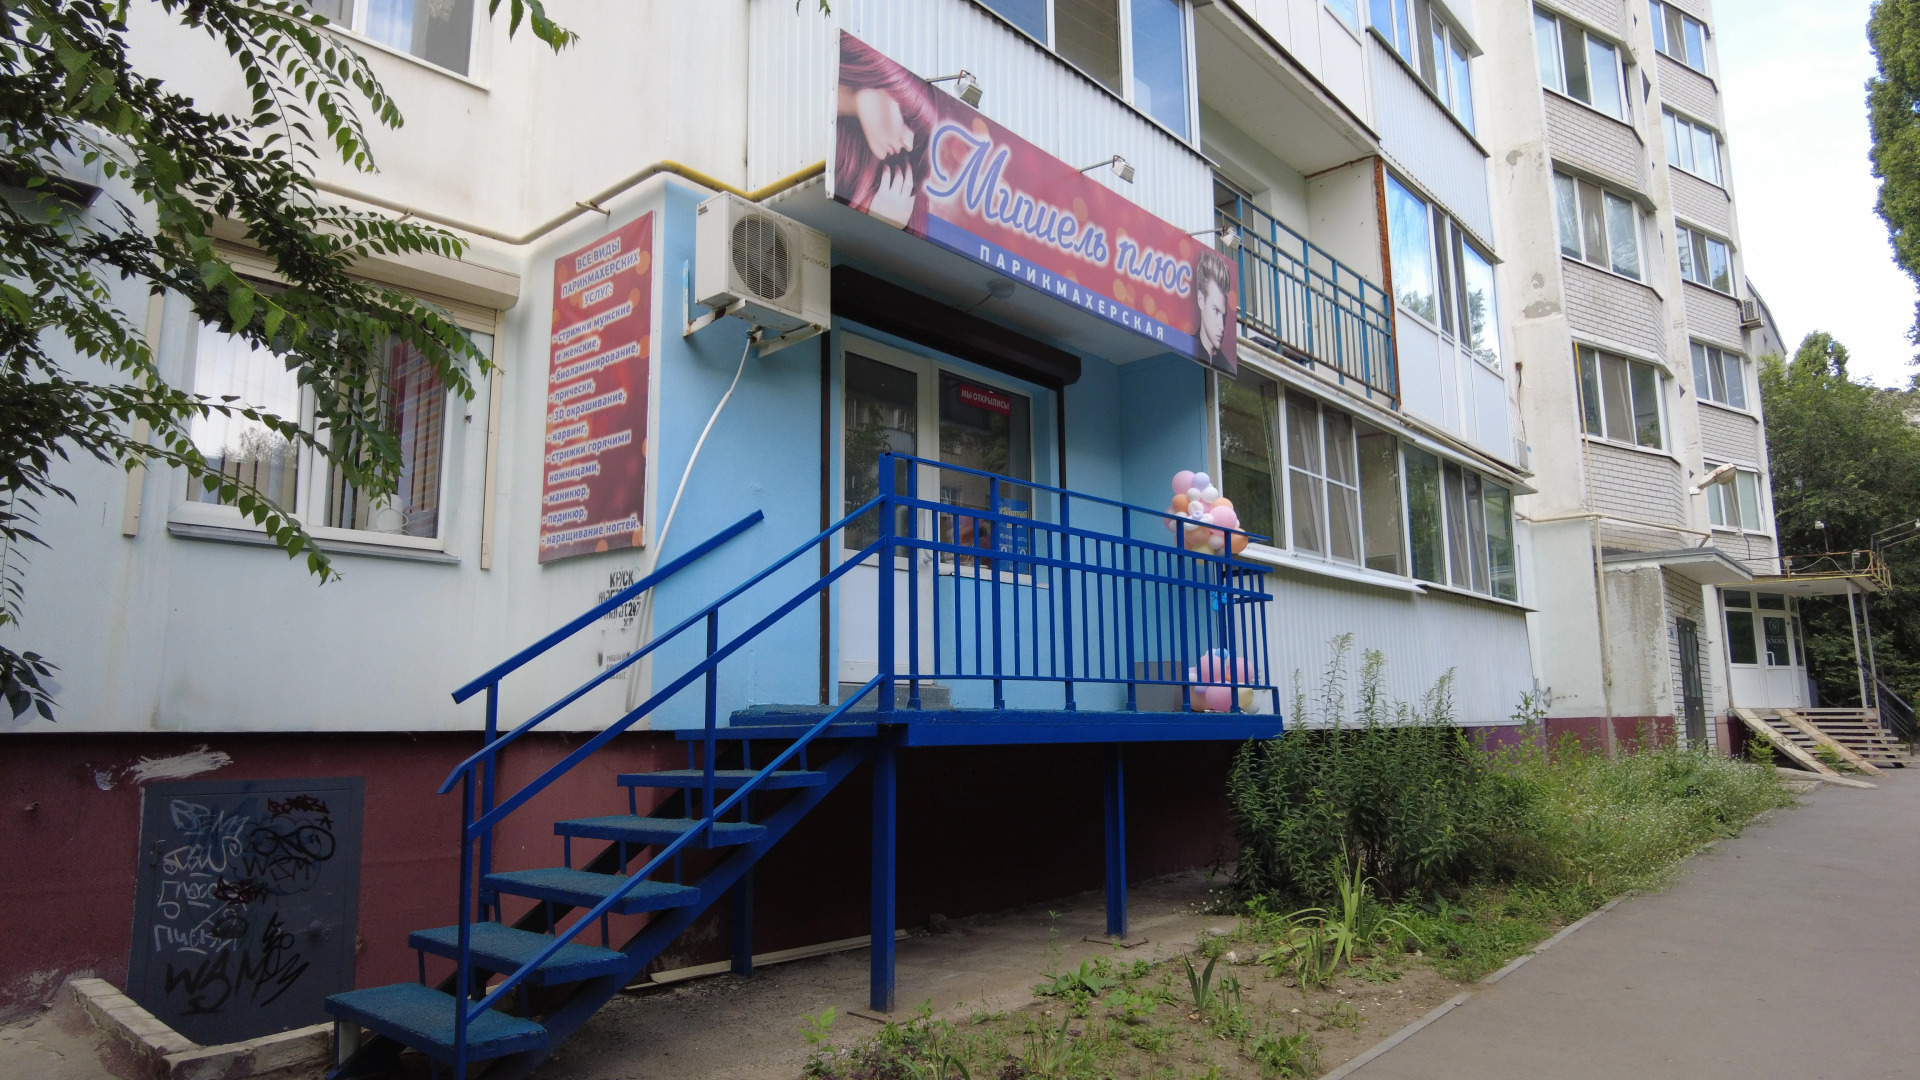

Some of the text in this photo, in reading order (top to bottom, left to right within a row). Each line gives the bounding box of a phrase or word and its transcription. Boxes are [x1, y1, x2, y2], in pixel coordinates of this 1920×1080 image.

[926, 125, 1191, 294] Мишель плюс
[577, 239, 621, 270] ВСЕ ВИДЫ
[562, 252, 639, 296] ПАРИКМАХЕРСКИХ
[584, 286, 613, 305] УСЛУГ:
[980, 244, 1164, 341] ПАРИКМАХЕРСКАЯ
[558, 304, 631, 342] стрижки мужские
[556, 345, 639, 381] биоламинирование,
[563, 338, 599, 359] женские,
[554, 383, 594, 402] прически,
[554, 391, 625, 421] 3D окрашивание,
[961, 389, 1010, 410] МЫ ОТКРЫЛИСЬ!
[551, 432, 631, 465] стрижки горячими
[552, 425, 588, 443] карвинг,
[549, 464, 599, 483] ножницами,
[549, 486, 588, 503] маникюр,
[547, 516, 639, 545] наращивание ногтей.
[548, 508, 587, 524] педикюр,
